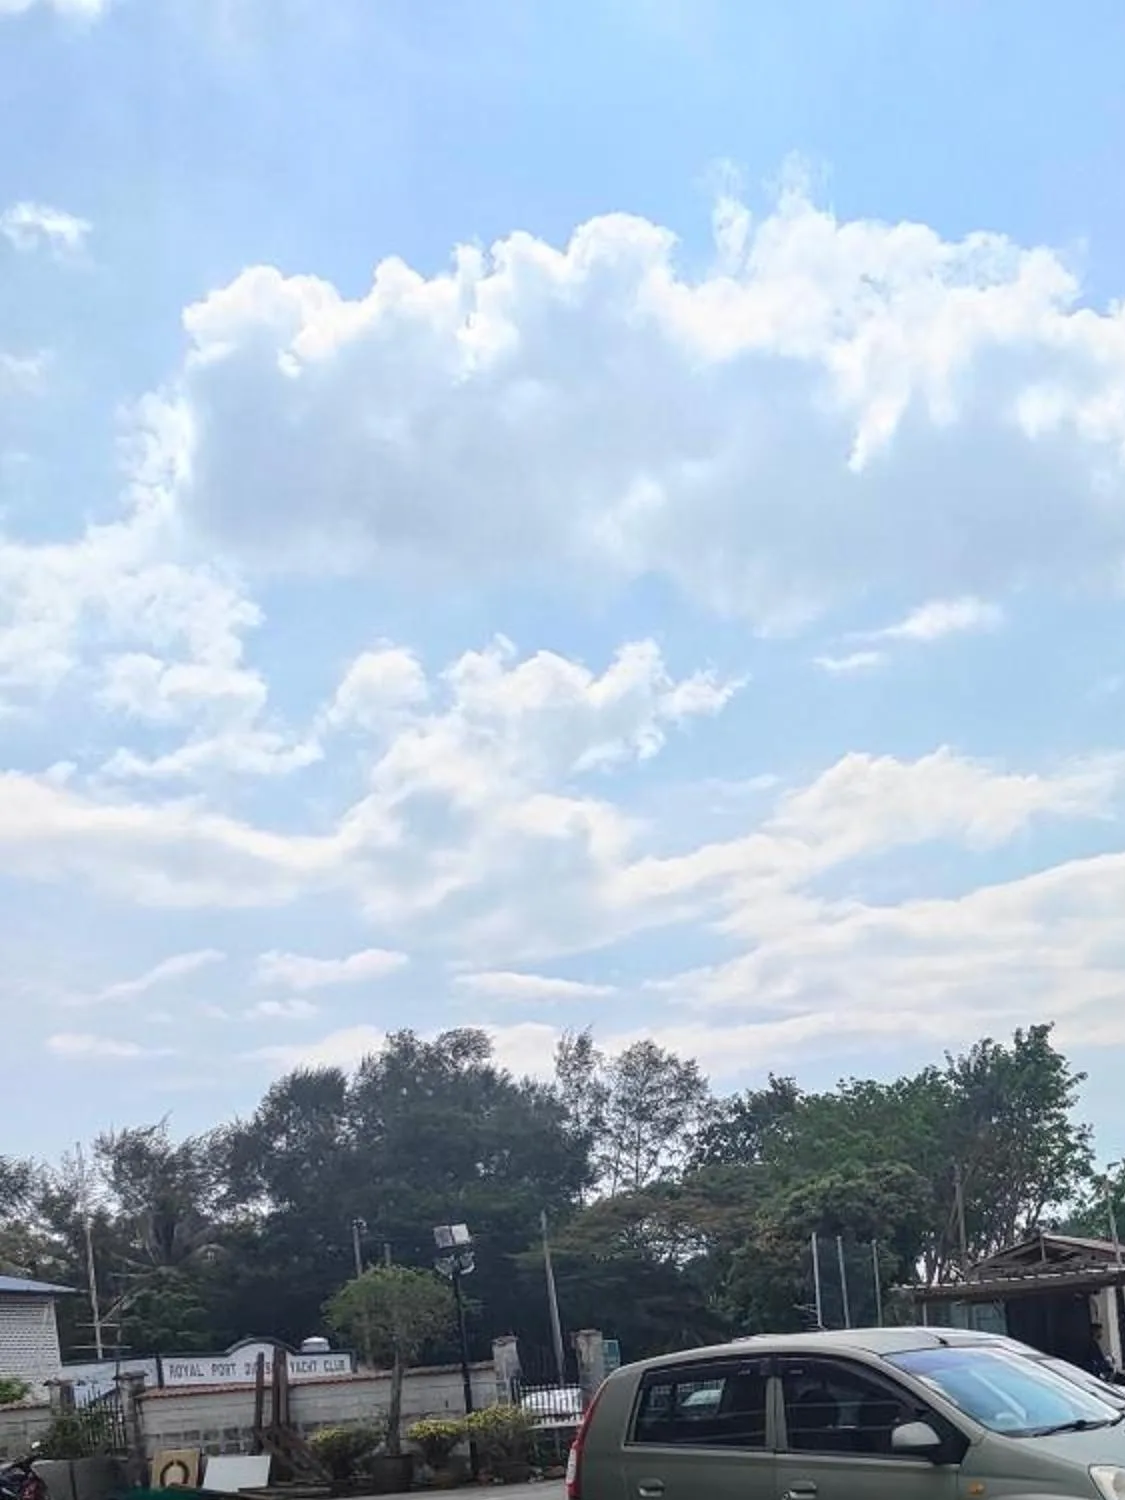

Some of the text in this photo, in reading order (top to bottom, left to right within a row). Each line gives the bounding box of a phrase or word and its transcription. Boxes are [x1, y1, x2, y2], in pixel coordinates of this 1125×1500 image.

[169, 1363, 205, 1379] ROYAL
[211, 1362, 237, 1377] PORT
[289, 1360, 318, 1374] YACHT
[323, 1359, 346, 1372] CLUB
